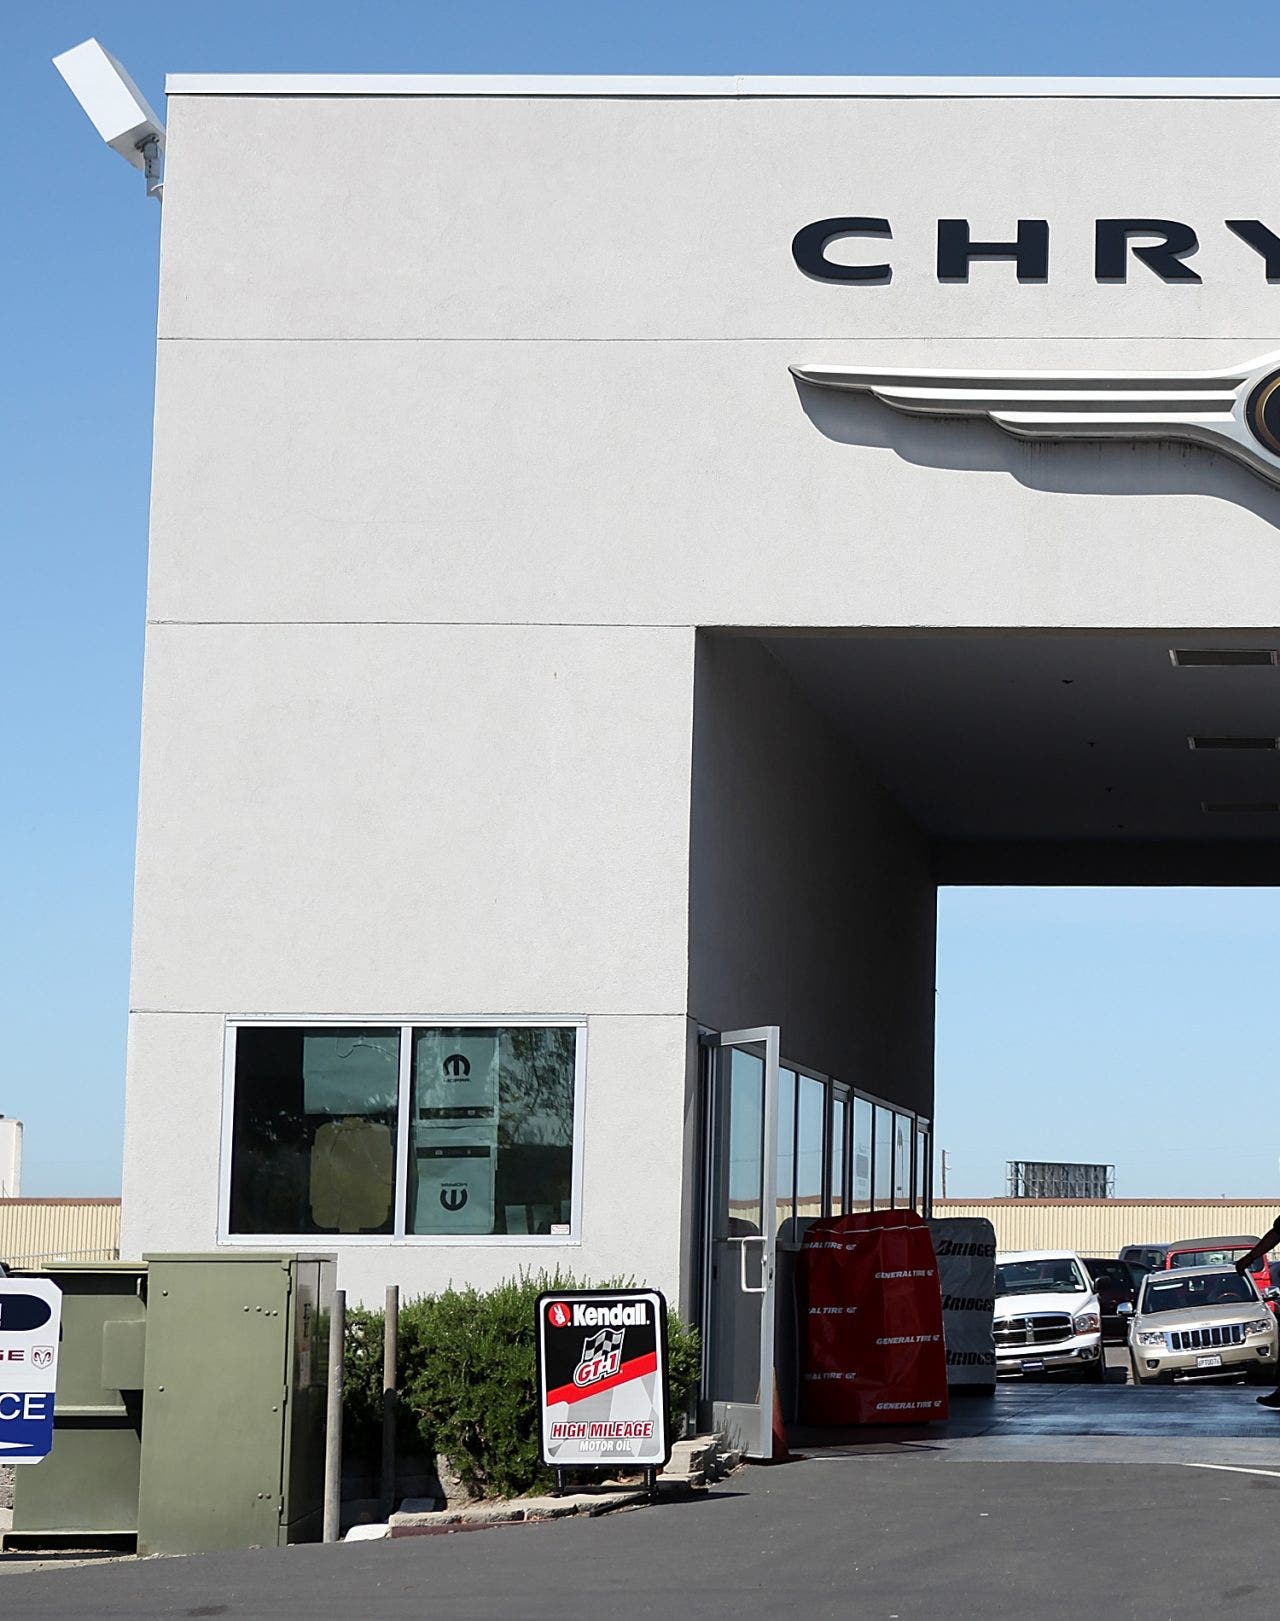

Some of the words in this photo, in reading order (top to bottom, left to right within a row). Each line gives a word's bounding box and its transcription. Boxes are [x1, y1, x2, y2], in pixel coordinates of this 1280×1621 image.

[875, 1270, 912, 1279] GENERAL
[573, 1303, 647, 1327] Kendall
[876, 1336, 915, 1345] GENERAL
[576, 1352, 619, 1384] GT-1
[876, 1402, 915, 1410] GENERAL
[552, 1423, 587, 1438] HIGH
[589, 1423, 653, 1438] MILEAGE
[580, 1440, 614, 1452] MOTOR
[616, 1440, 632, 1451] OIL
